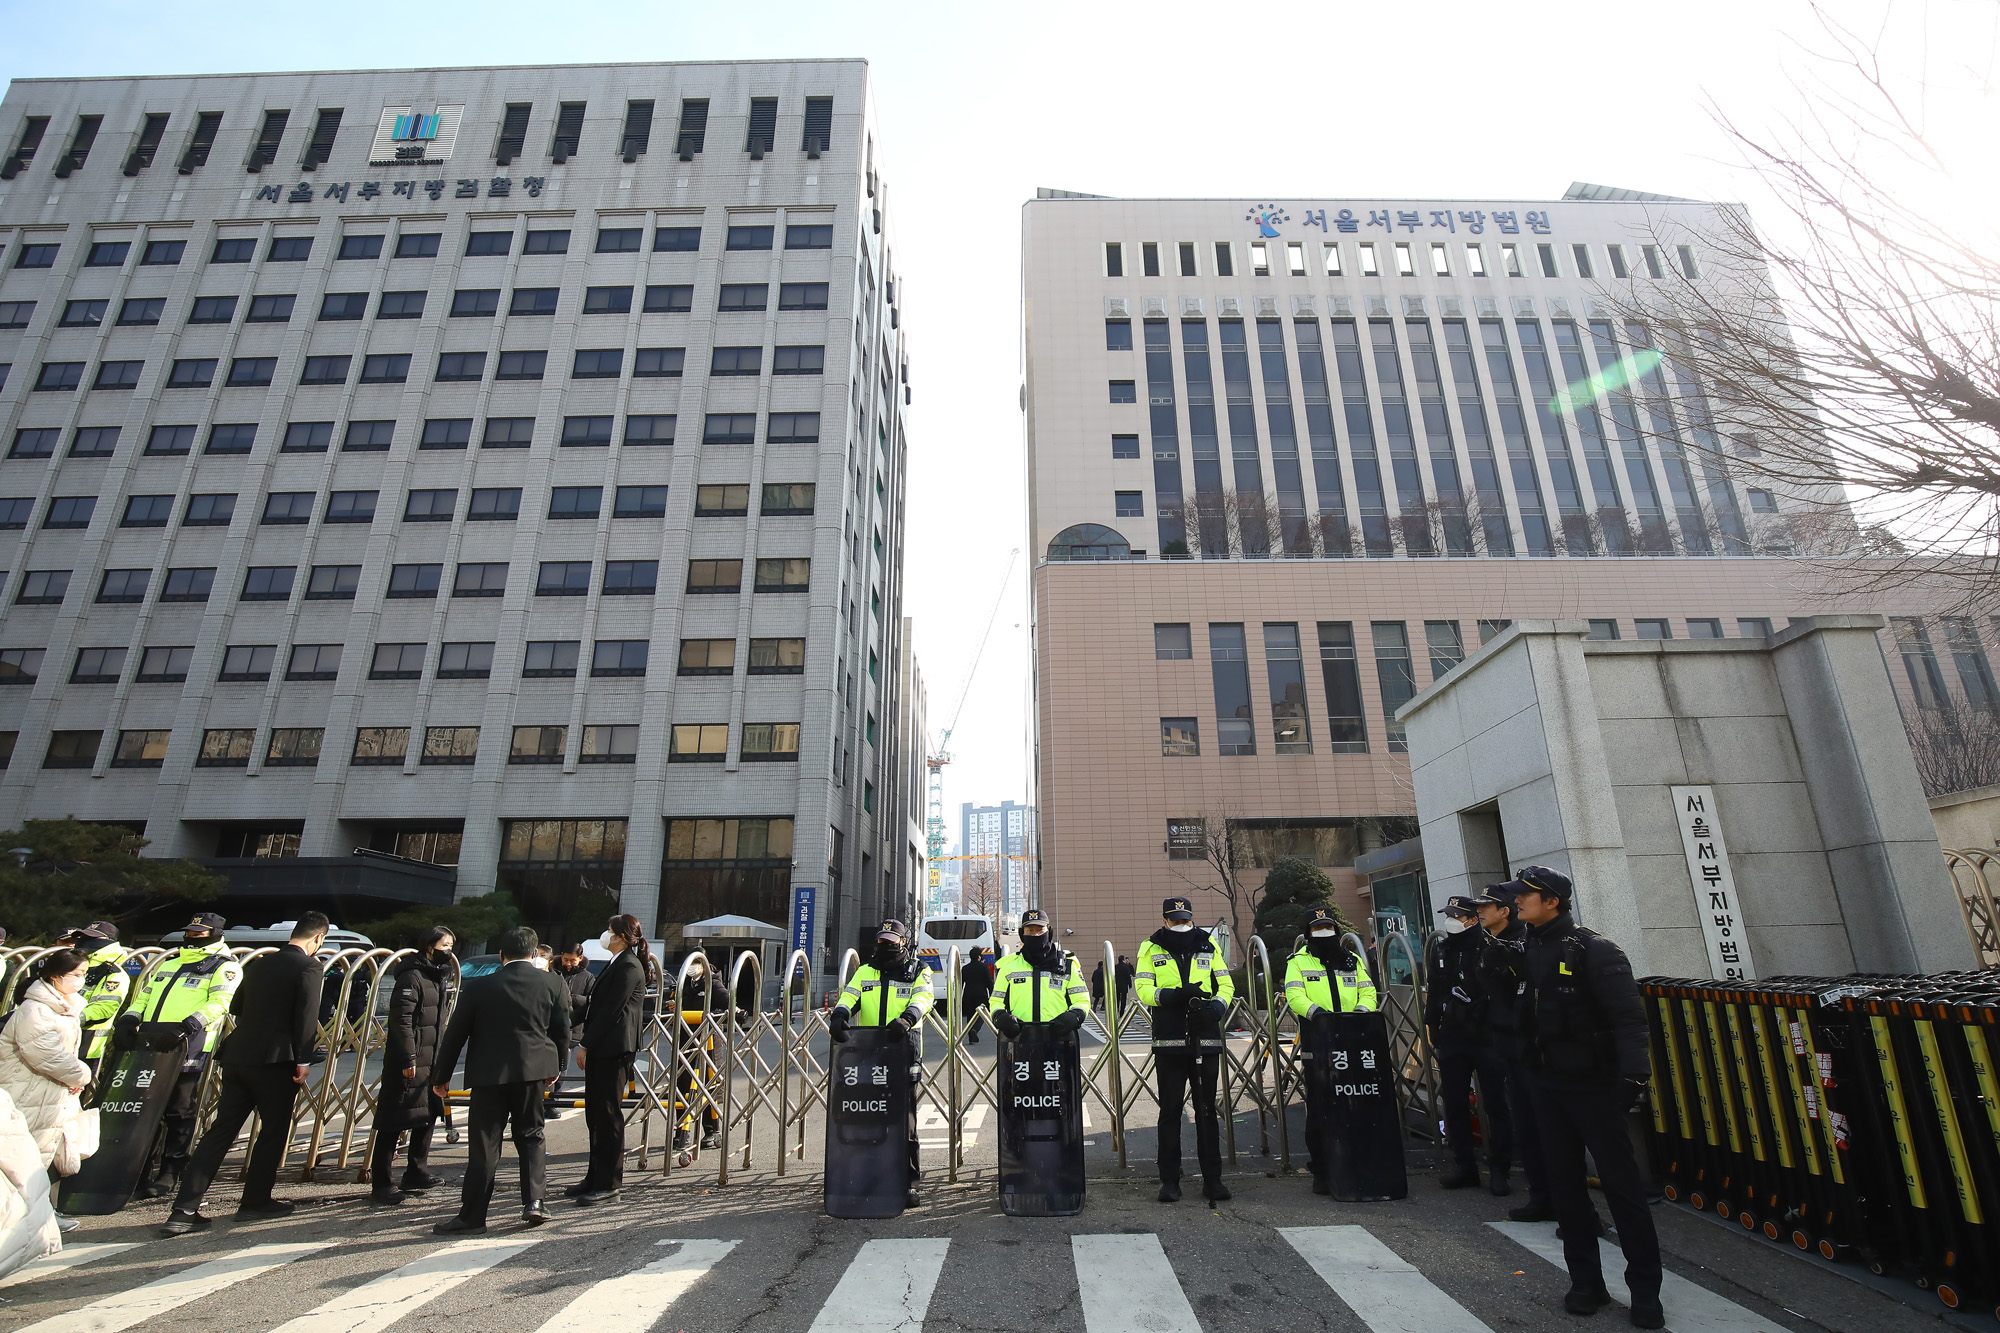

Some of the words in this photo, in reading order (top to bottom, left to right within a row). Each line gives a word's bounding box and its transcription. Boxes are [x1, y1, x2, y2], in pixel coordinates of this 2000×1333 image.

[256, 176, 545, 204] 서울서부지방검찰청
[1303, 208, 1552, 234] 서울서부지방법원
[1332, 1049, 1376, 1070] 경찰
[111, 1069, 156, 1089] 경찰
[843, 1065, 889, 1086] 경찰
[1014, 1060, 1061, 1081] 경찰
[1335, 1083, 1379, 1096] POLICE
[100, 1101, 143, 1113] POLICE
[842, 1100, 887, 1112] POLICE
[1014, 1095, 1061, 1108] POLICE
[1923, 1054, 1949, 1133] POLICE
[1948, 1147, 1967, 1201] LINE
